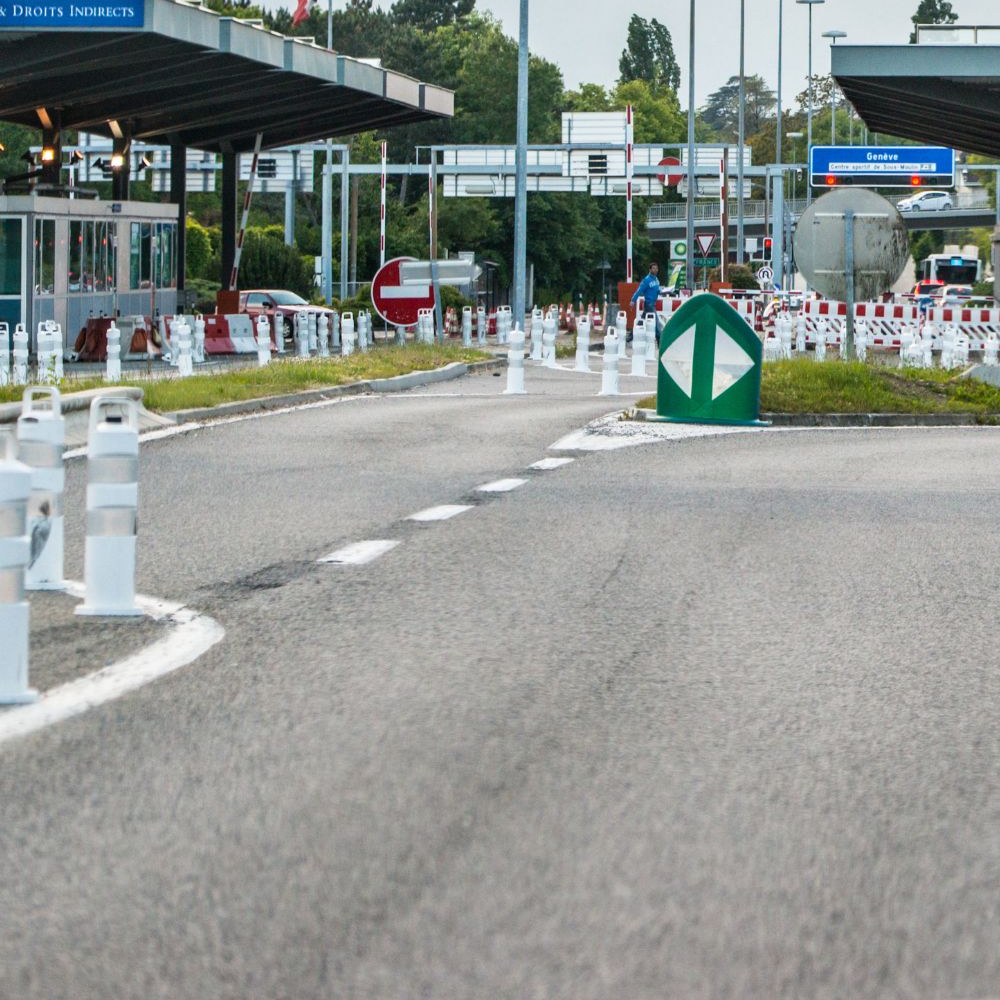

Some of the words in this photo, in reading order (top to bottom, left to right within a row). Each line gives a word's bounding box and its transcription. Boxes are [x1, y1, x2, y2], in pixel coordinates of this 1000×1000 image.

[13, 5, 63, 17] DROITS
[70, 5, 134, 17] INDIRECTS
[866, 152, 899, 161] Genève
